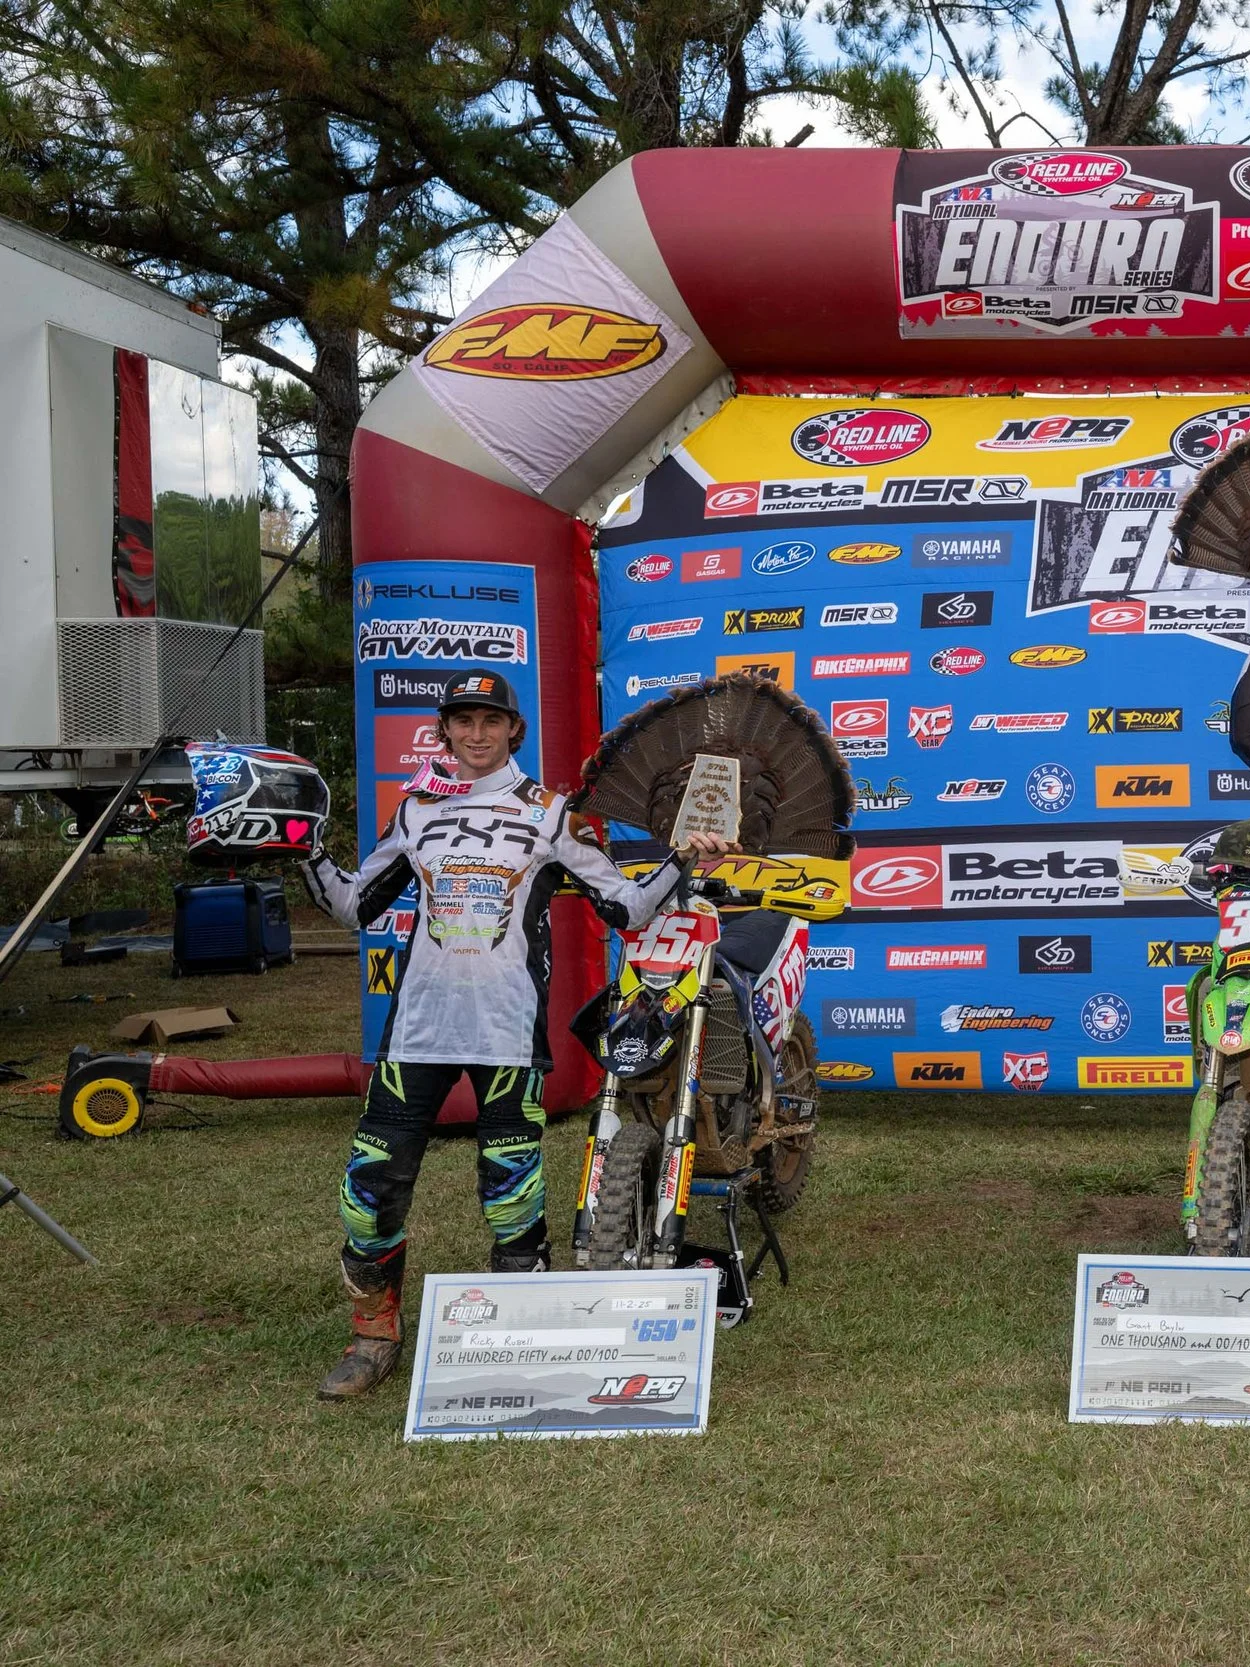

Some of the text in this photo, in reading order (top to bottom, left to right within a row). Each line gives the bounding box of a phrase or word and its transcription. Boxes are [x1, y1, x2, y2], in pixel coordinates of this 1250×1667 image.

[1031, 163, 1114, 177] RED LINE
[944, 187, 992, 201] AMA
[934, 204, 997, 219] NATIONAL
[935, 219, 1186, 286] ENDURO
[1123, 271, 1174, 287] SERIES
[985, 296, 1051, 308] Beta
[1070, 295, 1138, 314] MSR
[985, 308, 1051, 317] motorcycles
[423, 314, 661, 367] FMF
[832, 424, 920, 446] RED LINE
[843, 444, 887, 452] SYNTHETIC
[1099, 469, 1173, 488] AMA
[762, 481, 865, 500] Beta
[880, 479, 975, 504] MSR
[761, 498, 863, 513] motorcycles
[1087, 491, 1178, 511] NATIONAL
[829, 546, 901, 561] FMF
[942, 539, 1001, 555] YAMAHA
[640, 560, 671, 574] RED LINE
[373, 584, 520, 603] REKLUSE
[824, 607, 867, 623] MSR
[1149, 604, 1247, 621] Beta
[371, 621, 514, 639] ROCKY MOUNTAIN
[646, 618, 702, 637] WISECO
[1149, 621, 1245, 632] motorcycles
[945, 655, 982, 666] RED LINE
[1010, 647, 1087, 664] FMF
[639, 674, 699, 690] REKLUSE
[996, 713, 1068, 728] WISECO
[1034, 765, 1068, 780] SEAT
[1112, 776, 1173, 797] KTM
[1029, 784, 1072, 812] CONCEPTS
[949, 851, 1120, 881] Beta
[950, 885, 1120, 903] motorcycles
[847, 1007, 906, 1025] YAMAHA
[960, 1006, 1013, 1019] Enduro
[962, 1016, 1054, 1032] Engineering
[910, 1062, 967, 1081] KTM
[1086, 1062, 1184, 1084] PIRELLI
[685, 1286, 695, 1310] 0002
[1101, 1334, 1125, 1347] ONE
[1128, 1334, 1187, 1349] THOUSAND
[1190, 1338, 1211, 1349] and
[437, 1348, 618, 1364] SIX HUNDRED FIFTY and 00/100
